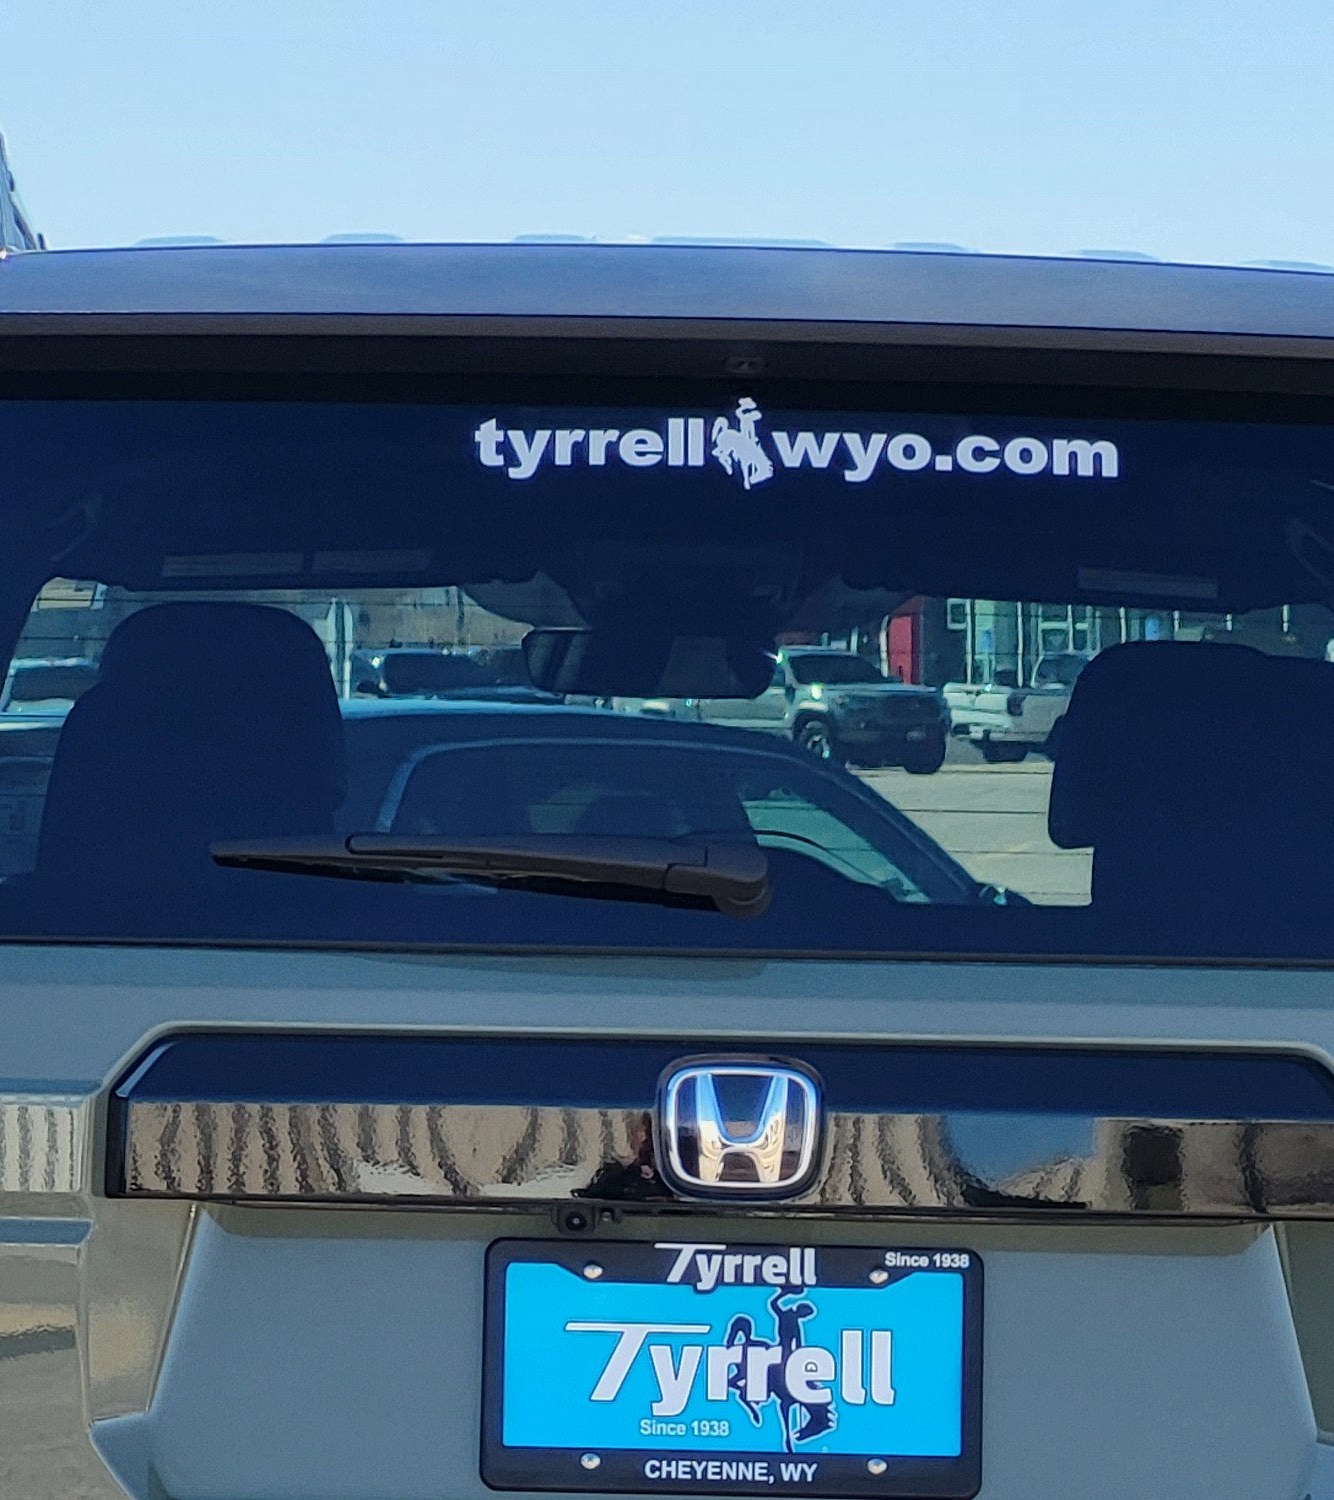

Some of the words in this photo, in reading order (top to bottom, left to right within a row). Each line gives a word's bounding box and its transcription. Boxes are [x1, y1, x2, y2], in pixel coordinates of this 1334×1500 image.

[654, 1242, 817, 1290] Tyrrell
[884, 1252, 930, 1268] Since
[932, 1253, 970, 1269] 1938
[565, 1322, 896, 1416] Tyrrell
[639, 1418, 687, 1436] Since
[691, 1420, 730, 1437] 1938
[644, 1460, 776, 1484] CHEYENNE,
[780, 1463, 818, 1483] WY
